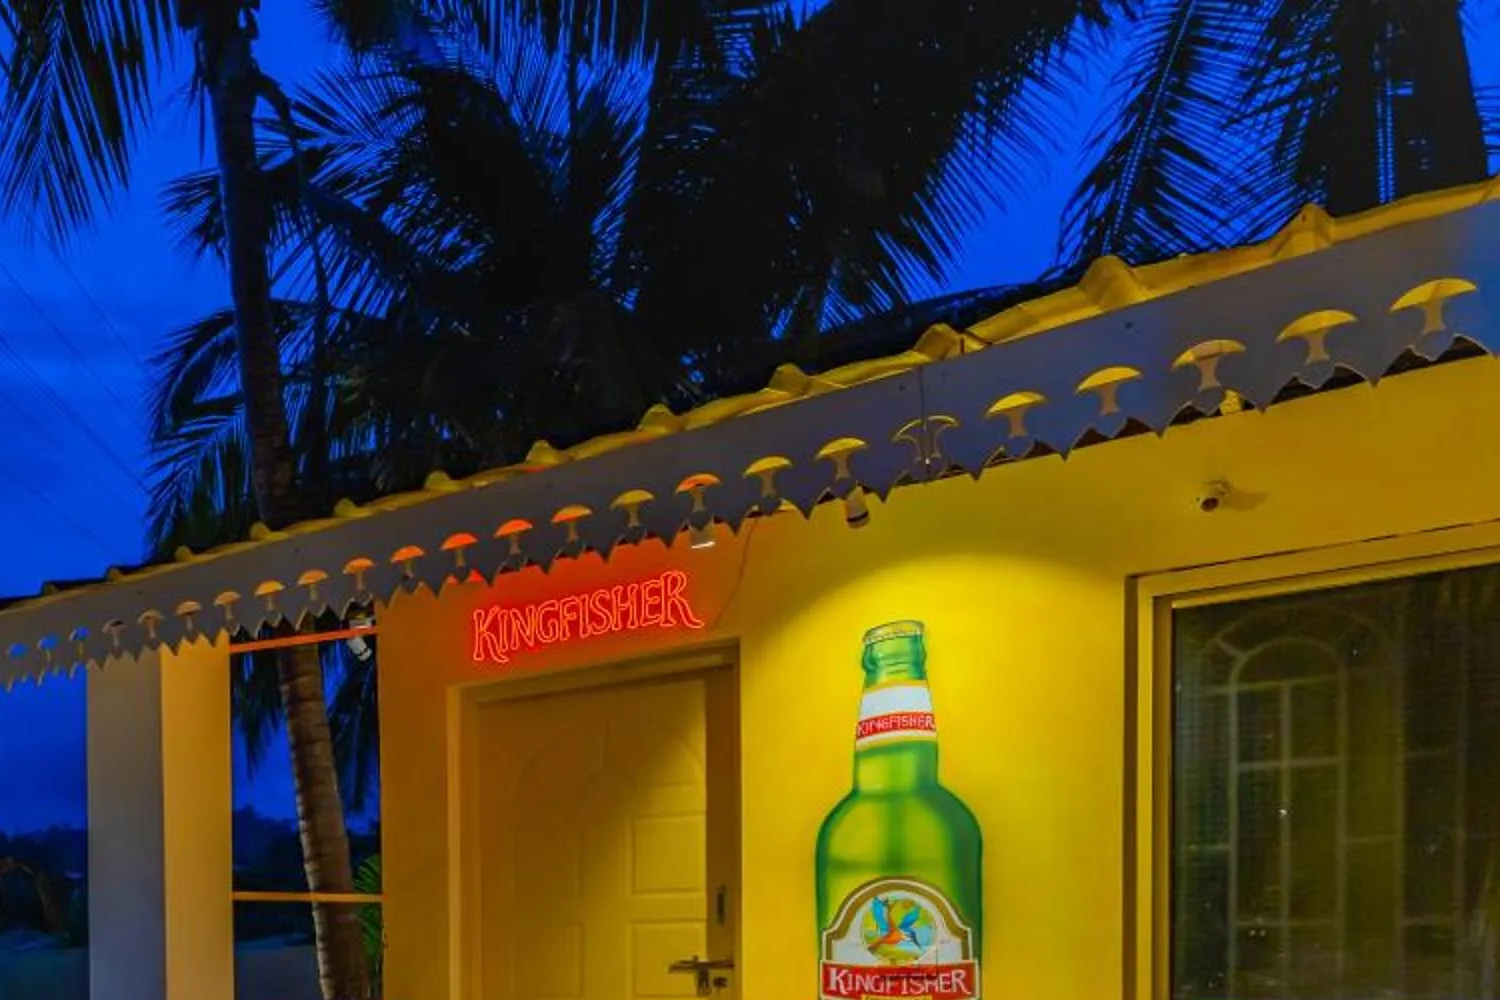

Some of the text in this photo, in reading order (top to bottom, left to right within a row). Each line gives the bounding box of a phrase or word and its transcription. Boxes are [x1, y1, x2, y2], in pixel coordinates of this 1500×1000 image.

[473, 570, 704, 663] KINGFISHER
[857, 713, 935, 737] KINGFISHER
[826, 967, 972, 995] KINGFISHER
